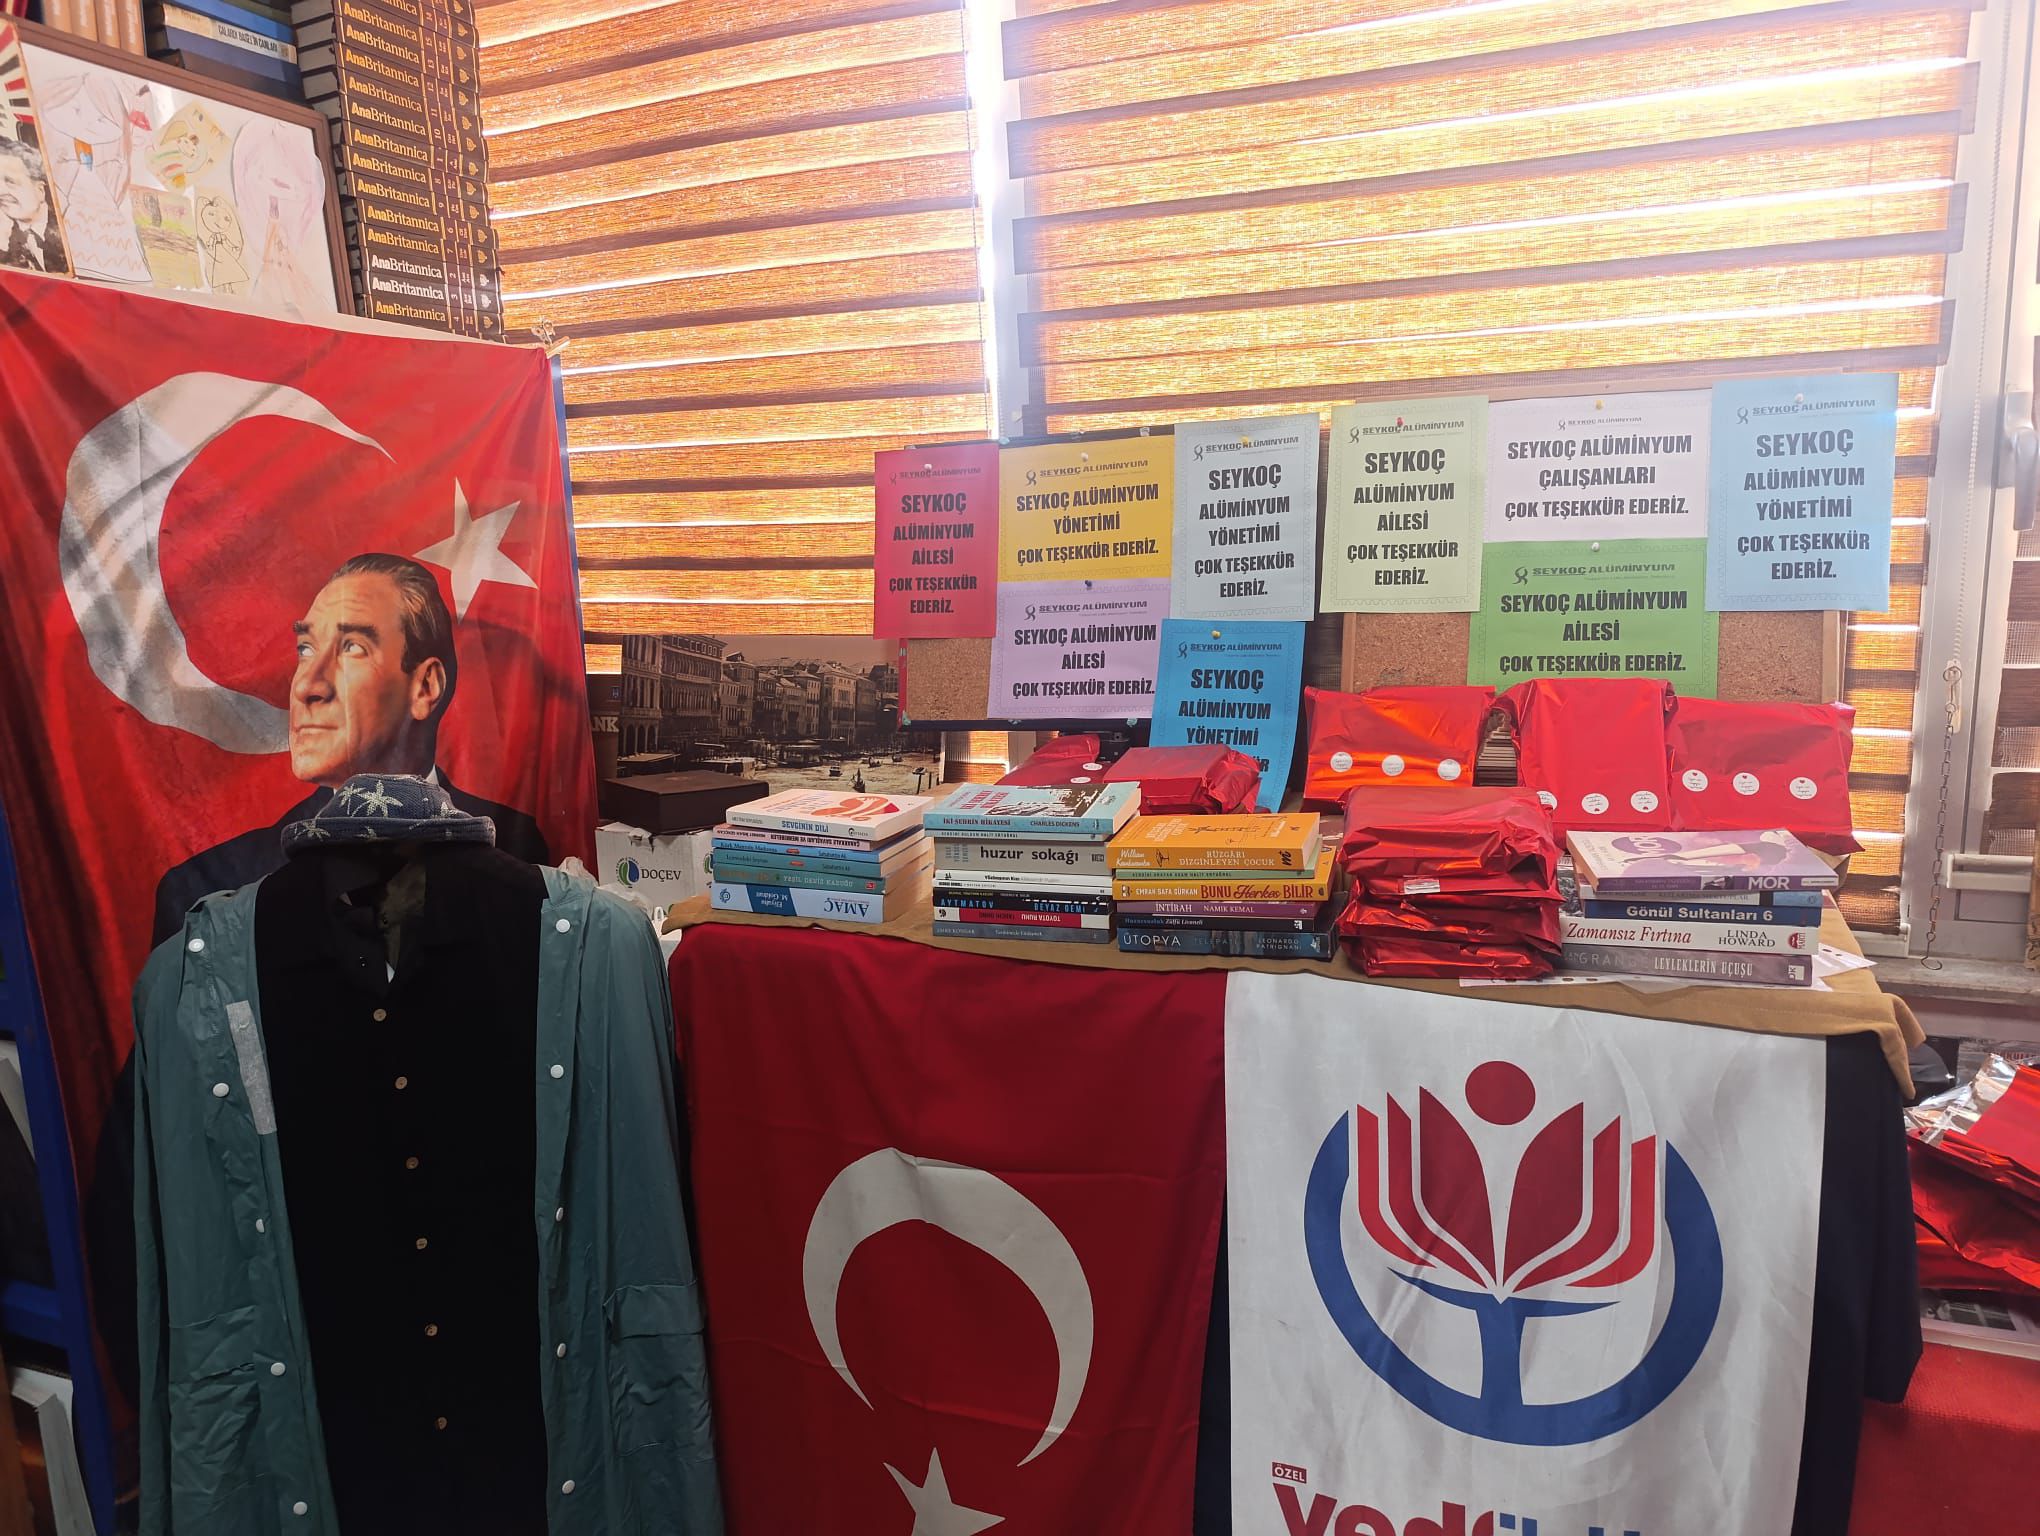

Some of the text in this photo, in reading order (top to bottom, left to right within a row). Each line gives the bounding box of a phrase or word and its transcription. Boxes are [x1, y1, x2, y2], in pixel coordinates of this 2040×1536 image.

[344, 2, 418, 42] AnaBritannica
[346, 24, 420, 64] AnaBritannica
[346, 48, 419, 87] AnaBritannica
[349, 76, 423, 113] AnaBritannica
[351, 102, 426, 136] AnaBritannica
[354, 128, 428, 162] AnaBritannica
[353, 153, 427, 184] AnaBritannica
[357, 178, 430, 208] AnaBritannica
[367, 207, 440, 232] AnaBritannica
[367, 228, 439, 254] AnaBritannica
[371, 254, 443, 279] AnaBritannica
[372, 276, 444, 300] AnaBritannica
[375, 300, 446, 322] AnaBritannica
[1507, 434, 1692, 461] SEYKOÇ ALÜMİNYUM
[1756, 428, 1854, 457] SEYKOÇ
[1365, 448, 1445, 474] SEYKOÇ
[1208, 464, 1282, 491] SEYKOÇ
[1539, 466, 1656, 490] ÇALIŞANLARI
[1744, 466, 1865, 491] ALÜMİNYUM
[902, 492, 966, 515] SEYKOÇ
[1016, 484, 1158, 512] SEYKOÇ ALÜMİNYUM
[1354, 483, 1454, 504] ALÜMİNYUM
[1200, 496, 1290, 520] ALÜMİNYUM
[1505, 494, 1689, 520] ÇOK TEŞEKKÜR EDERİZ.
[1757, 495, 1852, 521] YÖNETİMİ
[893, 523, 974, 541] ALÜMİNYUM
[1054, 511, 1120, 534] YÖNETİMİ
[1377, 510, 1428, 531] AİLESİ
[1209, 522, 1280, 547] YÖNETİMİ
[1737, 530, 1870, 555] ÇOK TEŞEKKÜR
[912, 548, 953, 565] AİLESİ
[1018, 539, 1159, 566] ÇOK TEŞEKKÜR EDERİZ.
[1347, 542, 1458, 562] ÇOK TEŞEKKÜR
[1194, 553, 1295, 577] ÇOK TEŞEKKÜR
[1771, 559, 1837, 580] EDERİZ.
[889, 575, 977, 593] ÇOK TEŞEKKÜR
[1220, 580, 1268, 598] EDERİZ.
[1374, 569, 1428, 586] EDERİZ.
[910, 598, 954, 614] EDERİZ.
[1501, 588, 1687, 613] SEYKOÇ ALÜMİNYUM
[1015, 624, 1156, 647] SEYKOÇ ALÜMİNYUM
[1563, 620, 1620, 642] AİLESİ
[1062, 652, 1105, 669] AİLESİ
[1500, 650, 1686, 675] ÇOK TEŞEKKÜR EDERİZ.
[1013, 678, 1155, 698] ÇOK TEŞEKKÜR EDERİZ.
[1191, 668, 1264, 693] SEYKOÇ
[1179, 700, 1271, 719] ALÜMİNYUM
[1186, 726, 1258, 746] YÖNETİMİ
[980, 845, 1024, 860] huzur
[1031, 848, 1079, 865] sokağı
[641, 868, 682, 882] DOÇEV
[1748, 877, 1790, 890] MOR
[1201, 885, 1231, 898] BUNU
[1283, 884, 1313, 898] BİLİR
[824, 896, 870, 917] AMAÇ
[941, 899, 994, 908] AYTMATOV
[1034, 903, 1060, 912] BEYAZ
[1156, 903, 1192, 912] İNTİBAH
[1626, 905, 1773, 921] Gönül Sultanları 6
[1040, 914, 1061, 922] TOYOTA
[1123, 932, 1181, 946] ÜTOPYA
[1567, 923, 1692, 943] Zamansız Fırtına
[1719, 938, 1776, 947] HOWARD
[1727, 930, 1767, 939] LINDA
[1654, 956, 1717, 974] LEYLEKLERİN
[1721, 959, 1753, 977] UÇUŞU
[1274, 1463, 1305, 1482] ÖZEL
